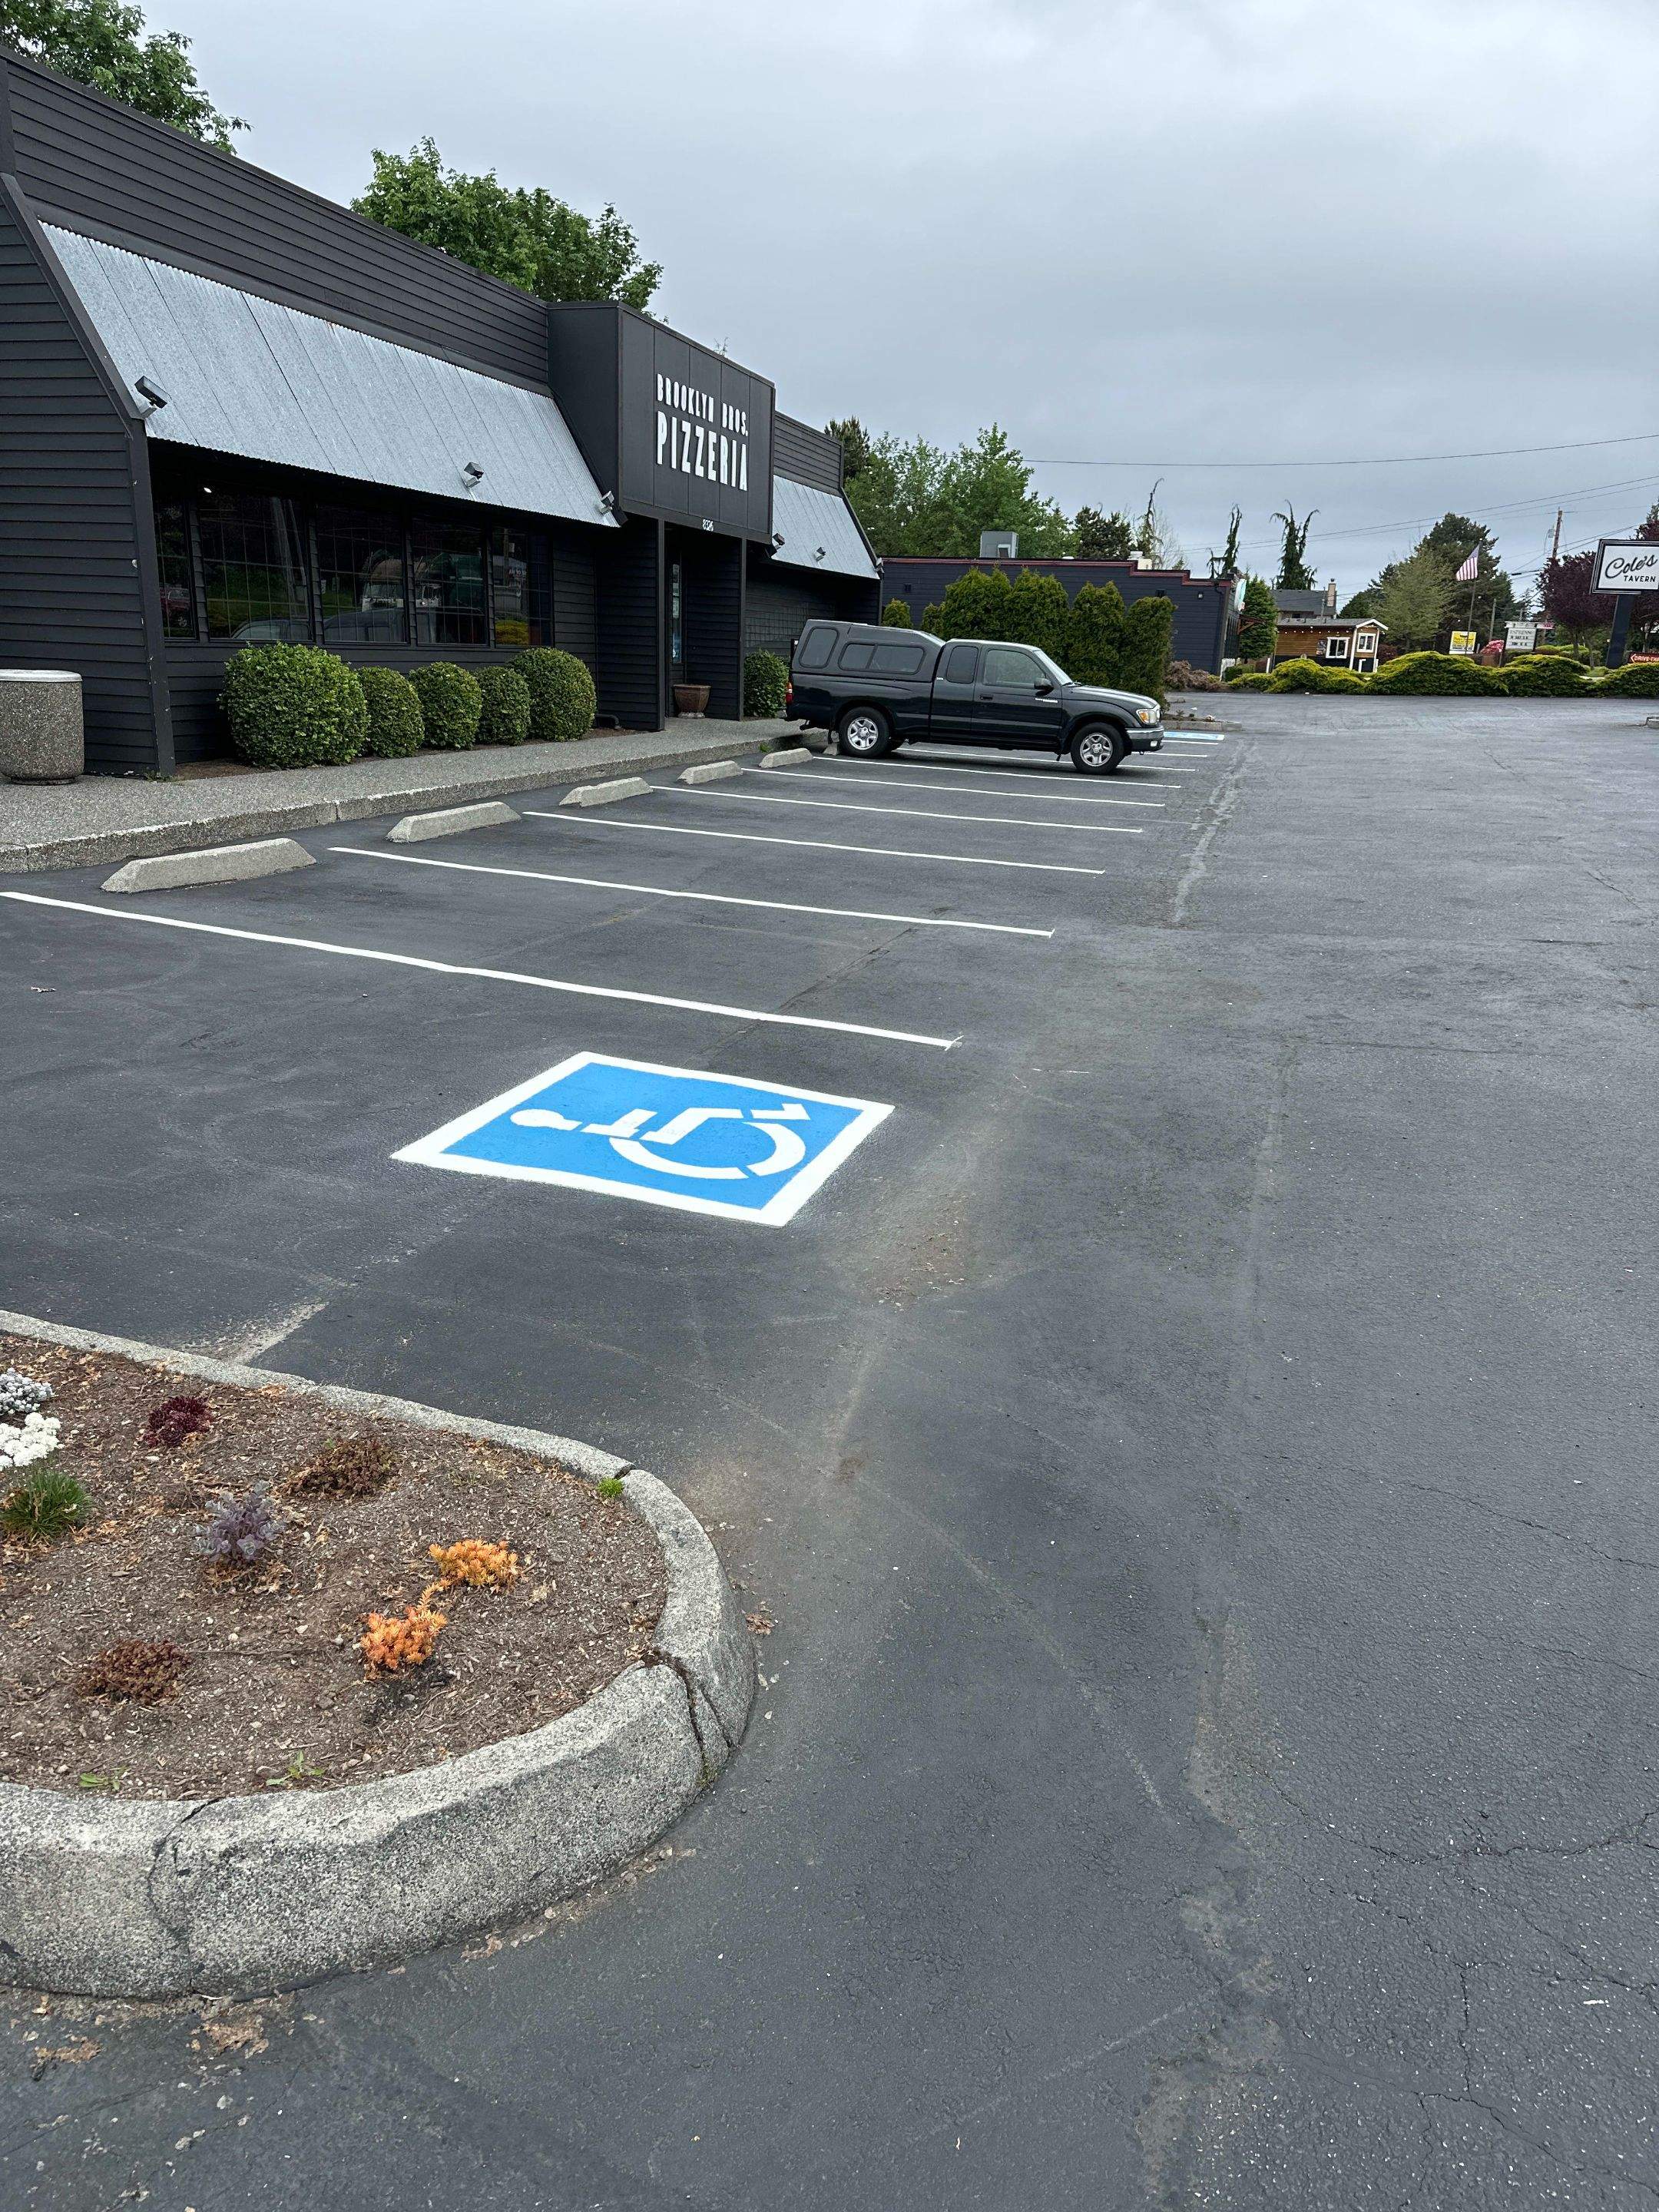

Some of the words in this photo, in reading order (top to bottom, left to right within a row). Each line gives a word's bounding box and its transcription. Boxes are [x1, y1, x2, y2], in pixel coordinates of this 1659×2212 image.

[657, 373, 714, 422] BROOKLYN
[722, 402, 749, 436] BROS.
[657, 410, 747, 492] PIZZERIA
[1604, 554, 1658, 579] Cole's
[1624, 575, 1656, 583] TAVERN
